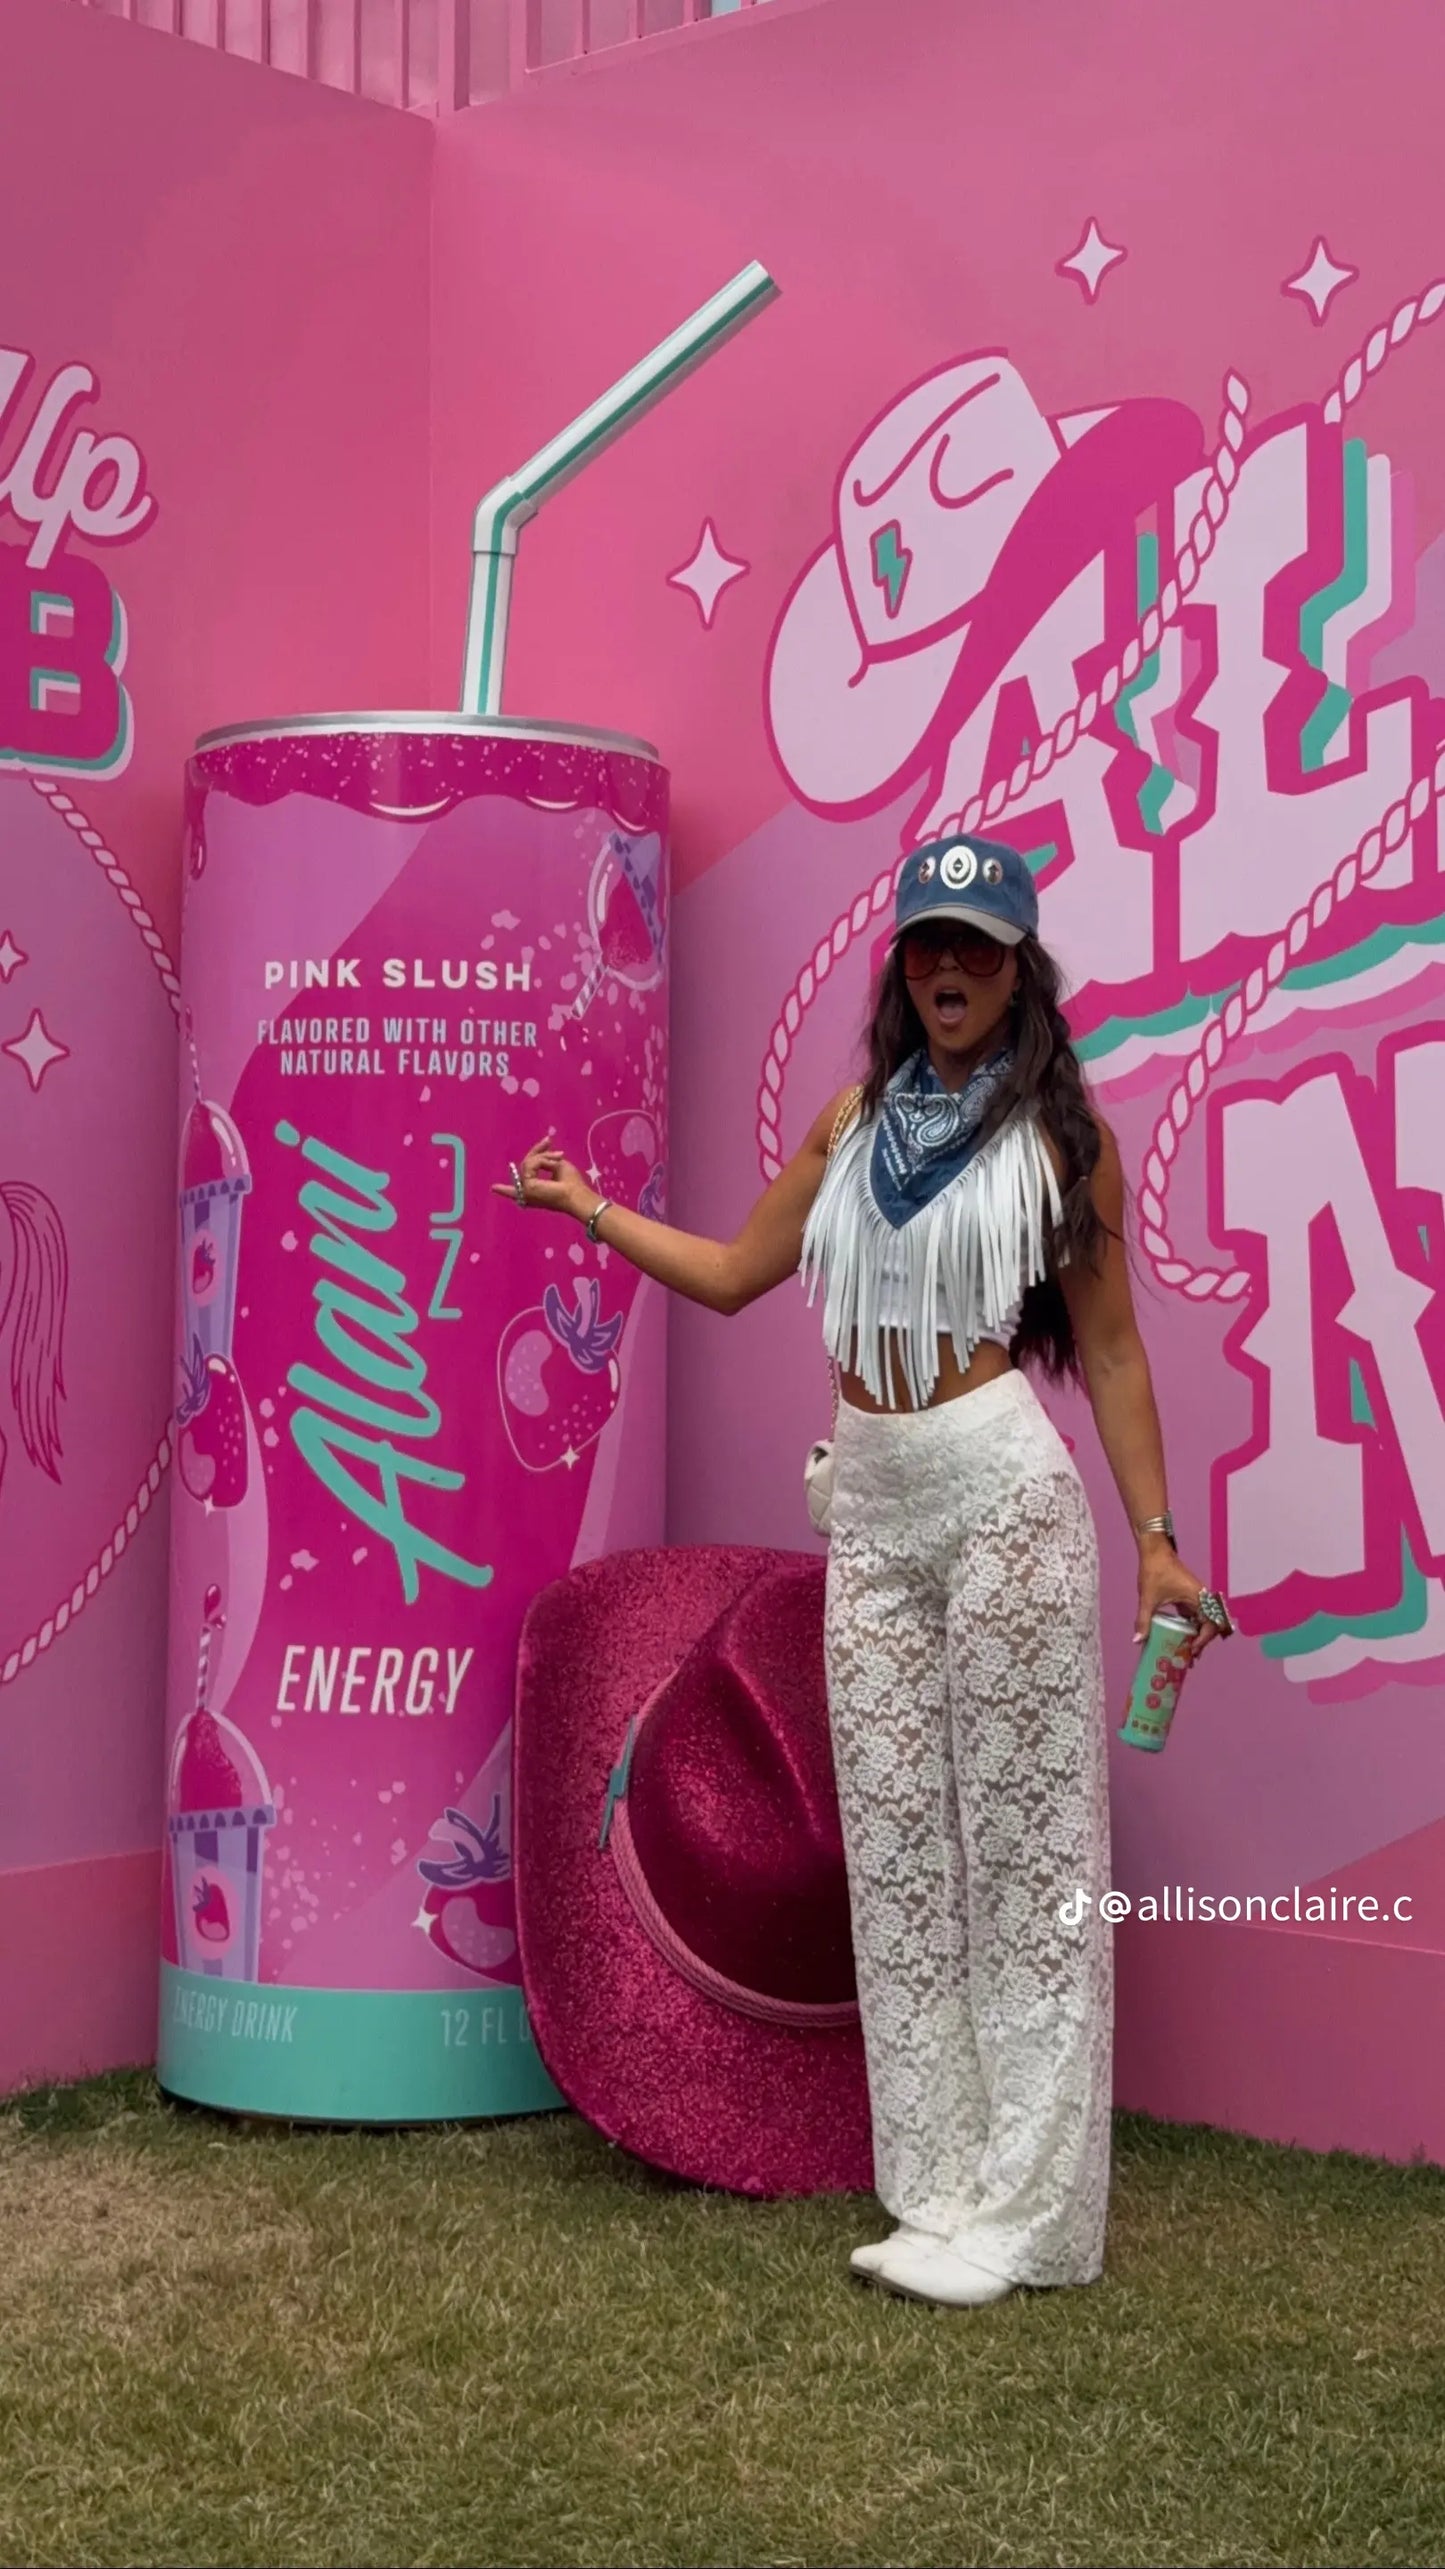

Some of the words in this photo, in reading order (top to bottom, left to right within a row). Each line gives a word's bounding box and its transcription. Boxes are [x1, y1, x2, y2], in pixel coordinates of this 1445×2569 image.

[264, 958, 361, 989] PINK
[383, 958, 531, 993] SLUSH
[257, 1018, 370, 1045] FLAVORED
[383, 1018, 447, 1044] WITH
[460, 1020, 537, 1048] OTHER
[281, 1049, 385, 1076] NATURAL
[398, 1051, 509, 1077] FLAVORS
[274, 1118, 494, 1605] Alani
[276, 1645, 474, 1716] ENERGY
[172, 1985, 229, 2032] ENERGY
[231, 1999, 298, 2043] DRINK
[441, 2008, 470, 2047] 12
[482, 2006, 508, 2045] FL
